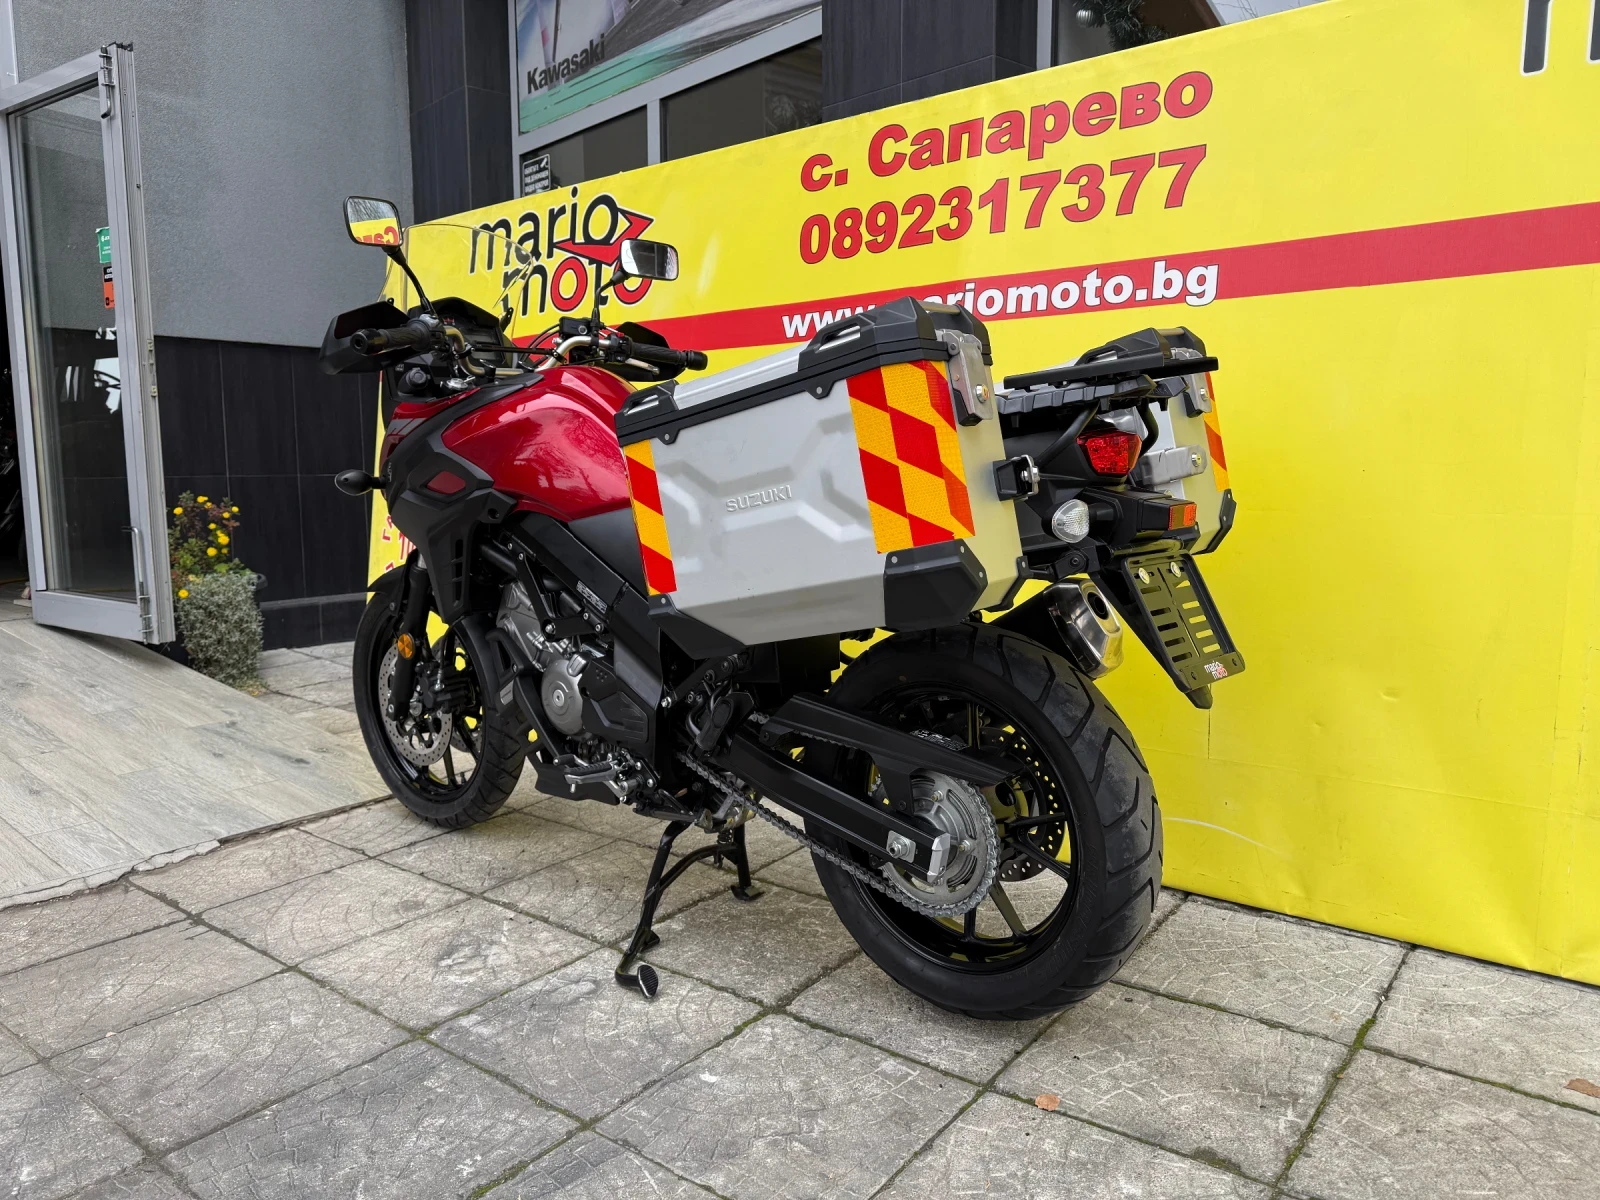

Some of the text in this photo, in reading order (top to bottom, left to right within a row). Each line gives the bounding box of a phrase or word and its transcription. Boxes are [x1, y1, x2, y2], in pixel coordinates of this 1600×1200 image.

[527, 33, 605, 94] Kawasaki
[800, 71, 1213, 191] с. Сапарево
[470, 186, 619, 274] mario
[800, 144, 1207, 264] 0892317377
[503, 256, 653, 316] moto
[781, 260, 1219, 338] wwriomoto.bg
[726, 484, 792, 512] SUZUKI
